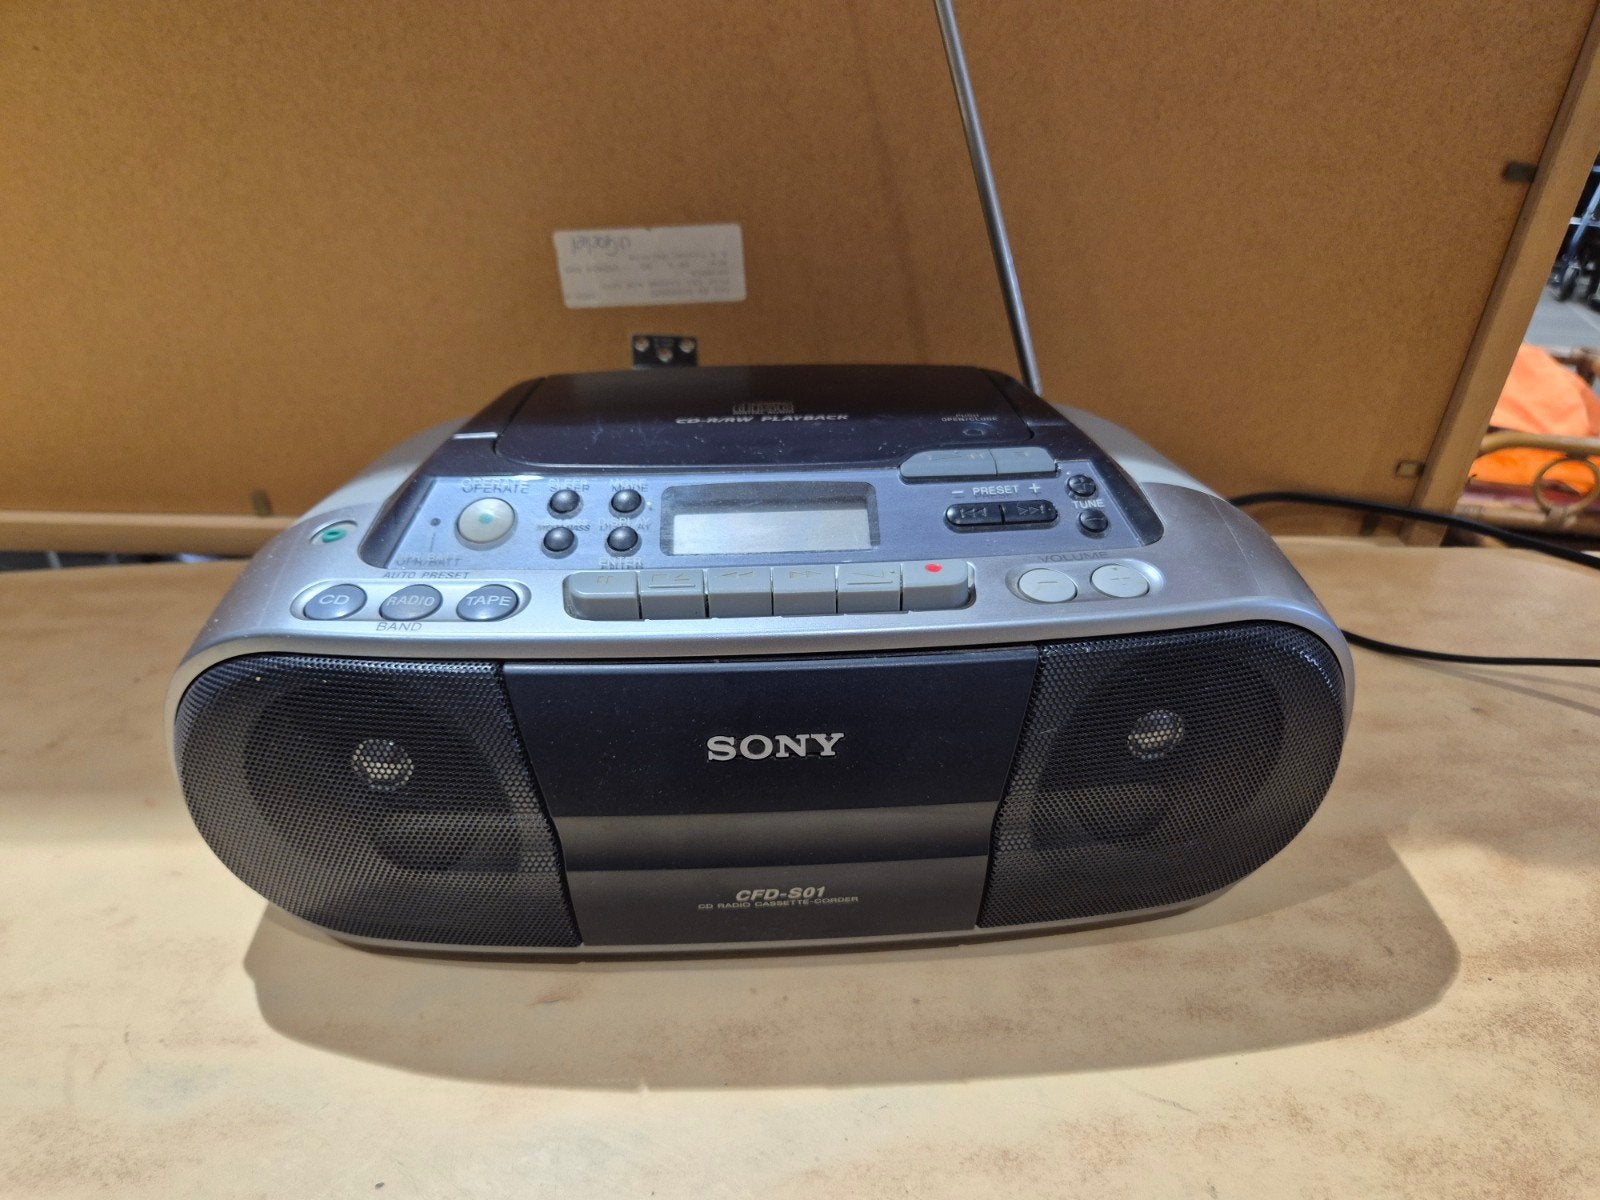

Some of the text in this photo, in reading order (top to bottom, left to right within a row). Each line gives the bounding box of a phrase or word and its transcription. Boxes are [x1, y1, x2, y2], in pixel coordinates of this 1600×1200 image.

[675, 414, 849, 424] CD-R/RW PLAYBACK
[461, 479, 530, 493] OPERATE
[972, 484, 1019, 496] PRESET
[1073, 500, 1105, 509] TUNE
[1038, 551, 1107, 563] VOLUME
[598, 557, 644, 570] ENTER
[382, 571, 470, 579] AUTO PRESET
[318, 594, 350, 605] CD
[385, 595, 436, 607] RADIO
[465, 595, 514, 606] TAPE
[375, 622, 423, 632] BAND
[706, 732, 845, 761] SONY
[735, 886, 826, 901] CFD-S01
[754, 896, 859, 907] CASSETTE-CORDER
